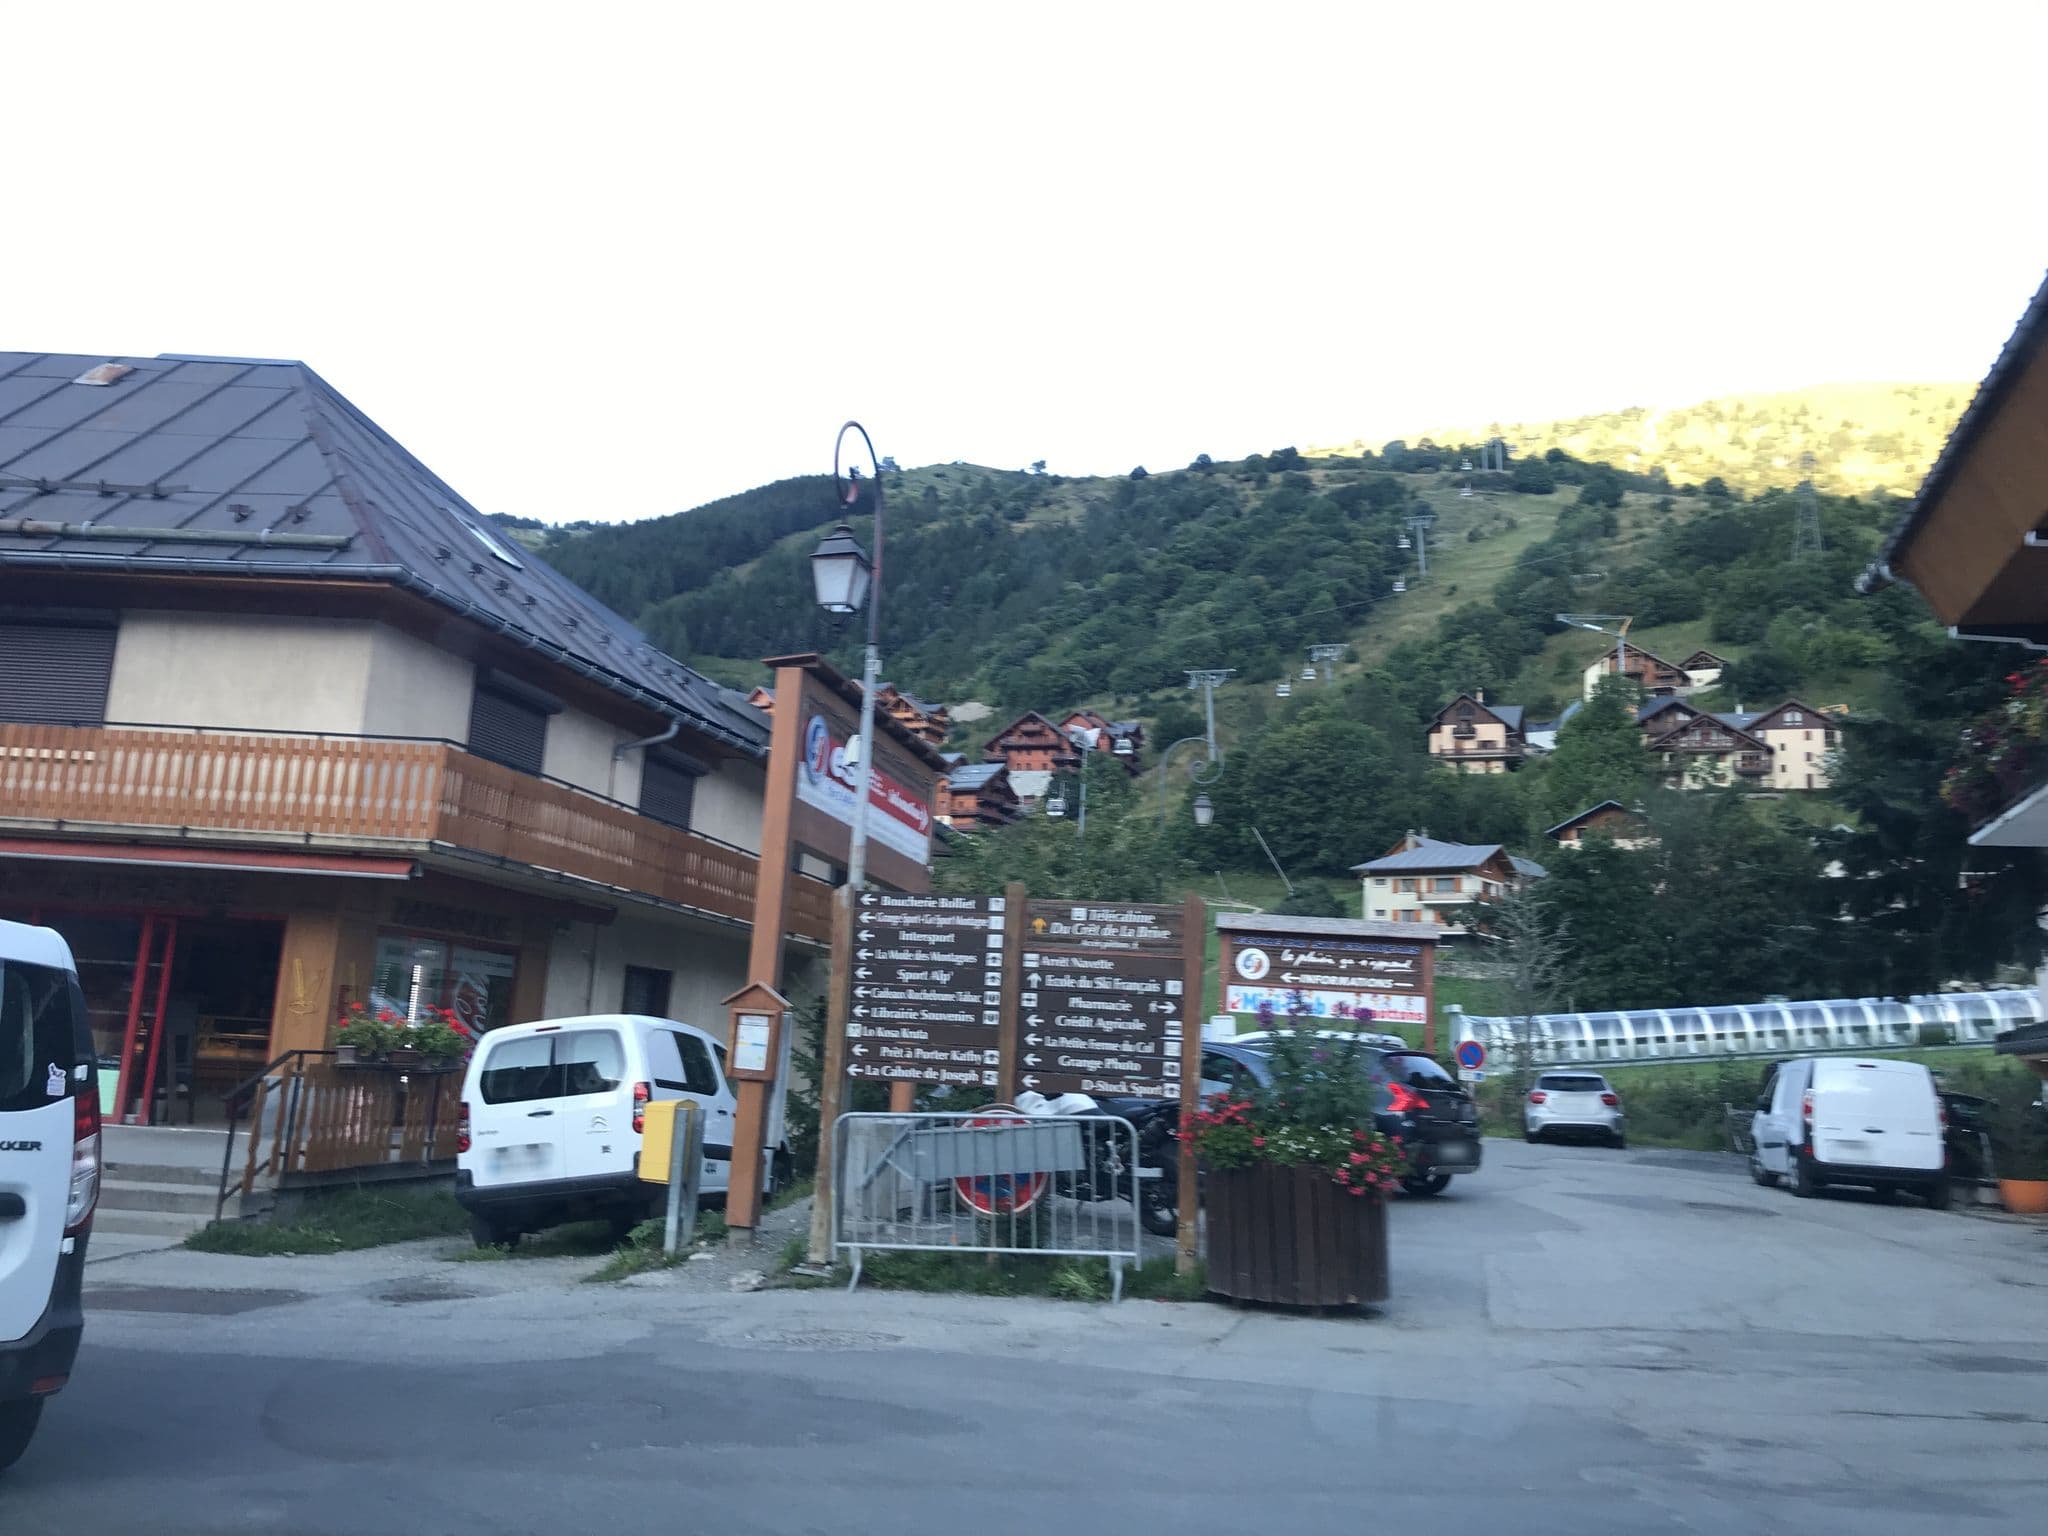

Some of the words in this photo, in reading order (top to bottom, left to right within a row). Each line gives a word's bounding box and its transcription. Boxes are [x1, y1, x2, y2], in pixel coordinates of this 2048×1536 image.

[880, 896, 938, 908] Boucherie
[1050, 922, 1071, 934] Du
[1100, 924, 1119, 937] de
[1120, 925, 1135, 937] La
[899, 931, 955, 945] Intersport
[875, 949, 887, 959] La
[1041, 956, 1070, 967] Arrêt
[1070, 957, 1115, 970] Navette
[896, 969, 928, 983] Sport
[1076, 975, 1093, 988] du
[1093, 977, 1112, 989] Ski
[1112, 977, 1161, 995] Français
[1068, 996, 1133, 1012] Pharmacie
[870, 1007, 919, 1019] Librairie
[919, 1009, 976, 1023] Souvenirs
[1054, 1015, 1094, 1028] Crédit
[1094, 1017, 1147, 1032] Agricole
[1044, 1035, 1058, 1047] La
[1058, 1036, 1088, 1049] Petite
[1088, 1038, 1120, 1051] Ferme
[879, 1046, 904, 1058] Prêt
[904, 1047, 913, 1058] à
[913, 1048, 950, 1061] Porter
[1057, 1055, 1104, 1072] Grange
[1104, 1057, 1142, 1071] Photo
[864, 1064, 880, 1076] La
[922, 1067, 939, 1079] de
[939, 1069, 979, 1084] Joseph
[1129, 1082, 1163, 1098] Sport
